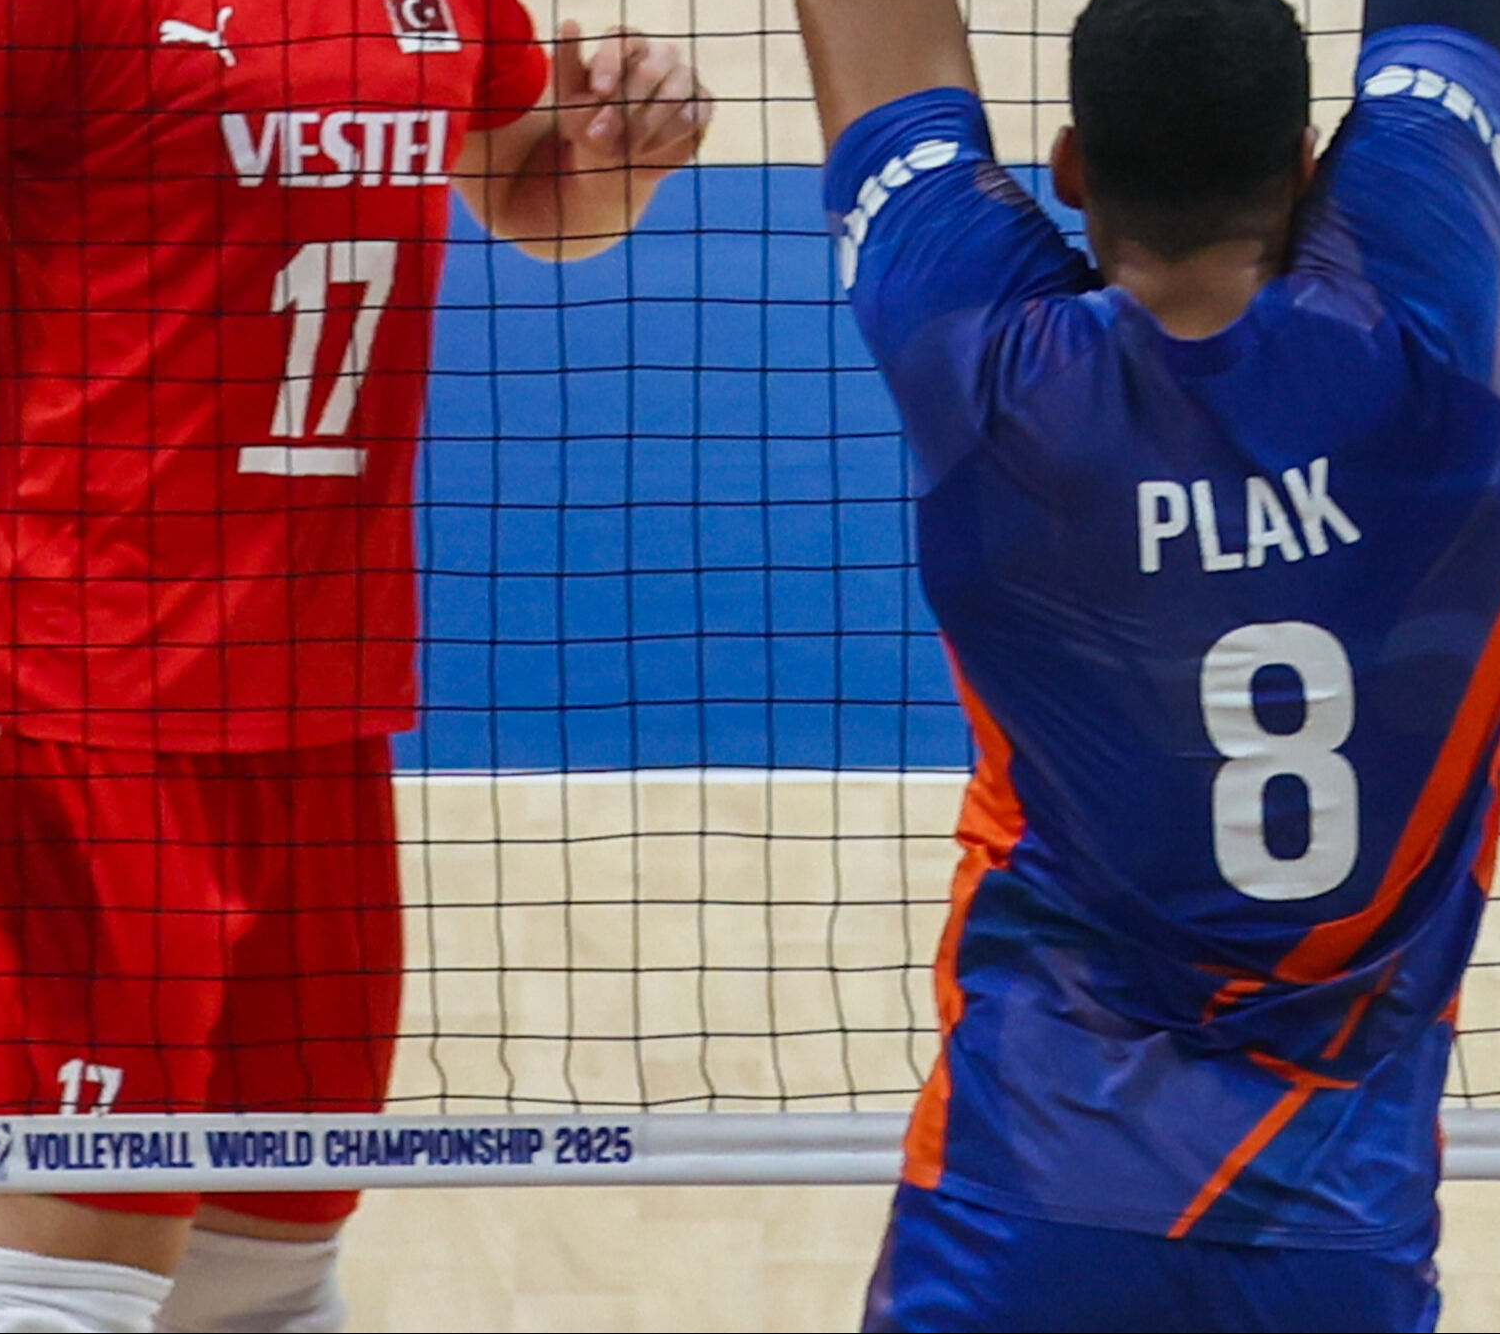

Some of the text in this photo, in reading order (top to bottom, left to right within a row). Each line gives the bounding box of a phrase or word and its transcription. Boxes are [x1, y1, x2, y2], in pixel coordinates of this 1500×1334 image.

[220, 111, 450, 187] VESTEL
[270, 240, 398, 437] 17
[1137, 456, 1362, 573] PLAK
[1201, 621, 1360, 901] 8
[57, 1058, 124, 1116] 17
[24, 1131, 195, 1170] VOLLEYBALL
[204, 1130, 313, 1169] WORLD
[324, 1128, 543, 1167] CHAMPIONSHIP
